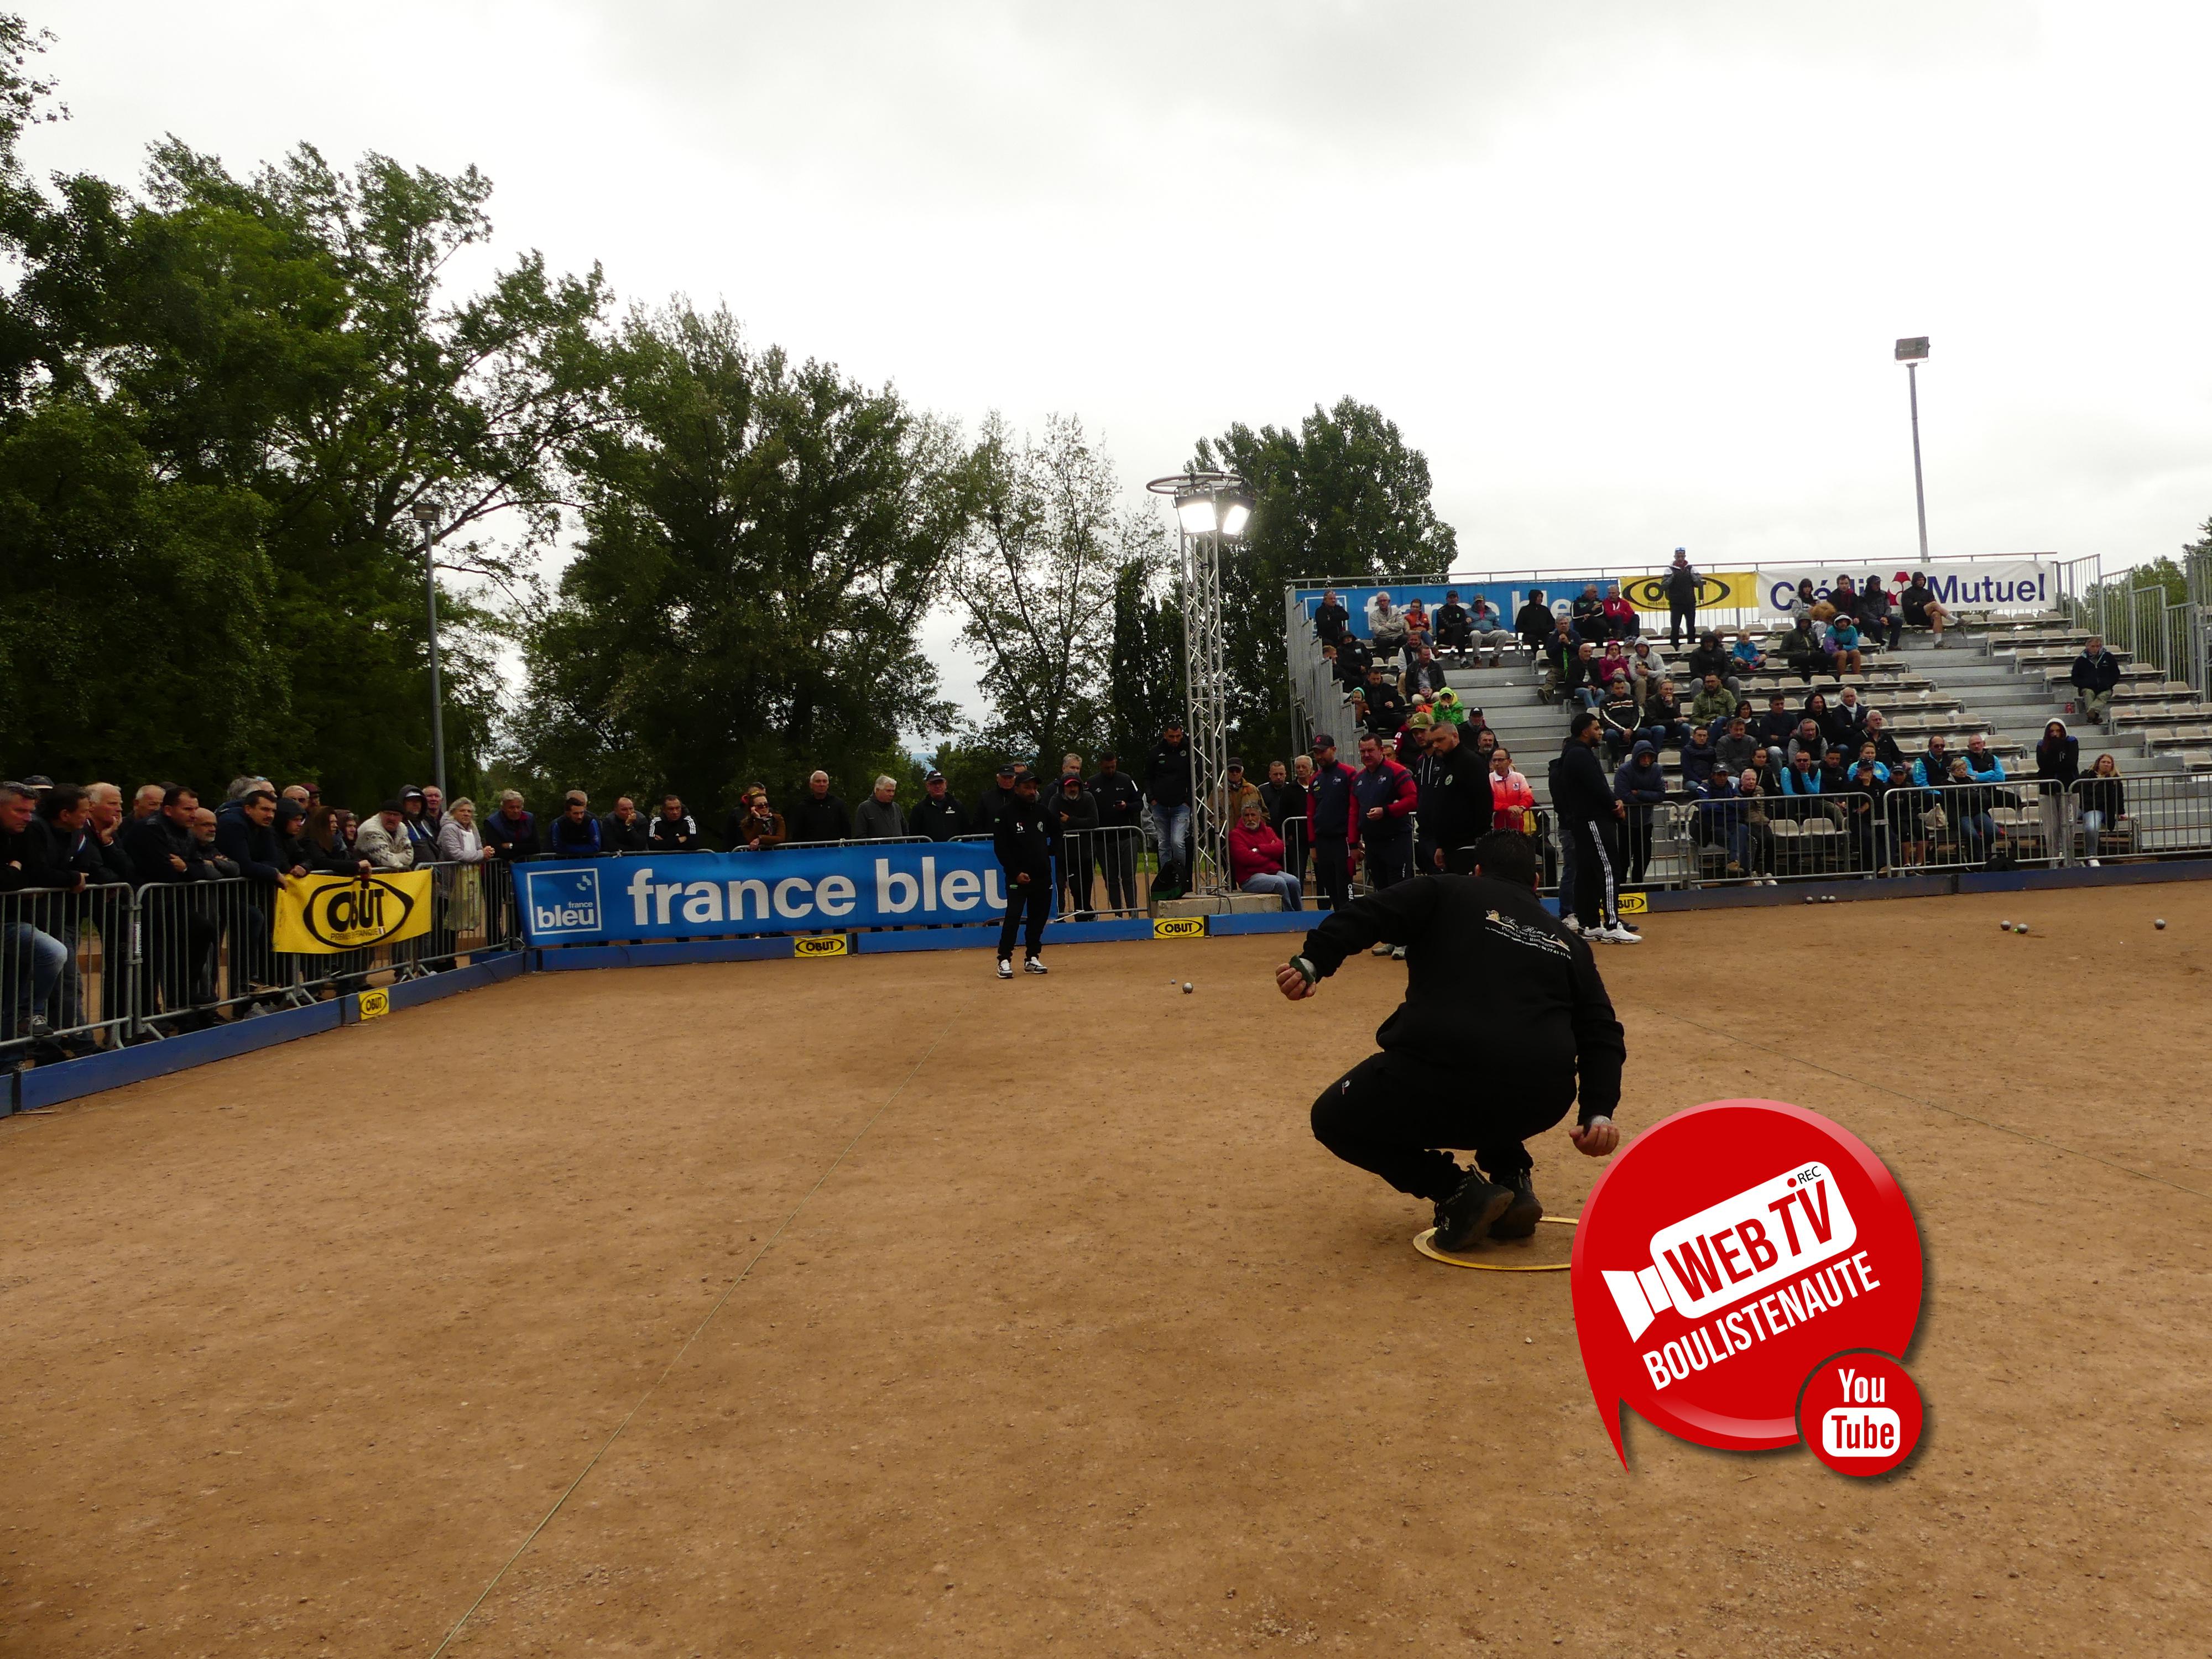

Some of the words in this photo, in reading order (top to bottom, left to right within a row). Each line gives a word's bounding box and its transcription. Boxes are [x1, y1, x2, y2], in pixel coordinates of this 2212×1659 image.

[1927, 573, 2045, 603] Mutuel
[628, 868, 856, 926] france
[1618, 899, 1635, 909] BUT
[538, 905, 594, 928] bleu
[1165, 923, 1193, 933] OBUT
[806, 941, 834, 952] OBUT
[366, 997, 382, 1011] OBUT
